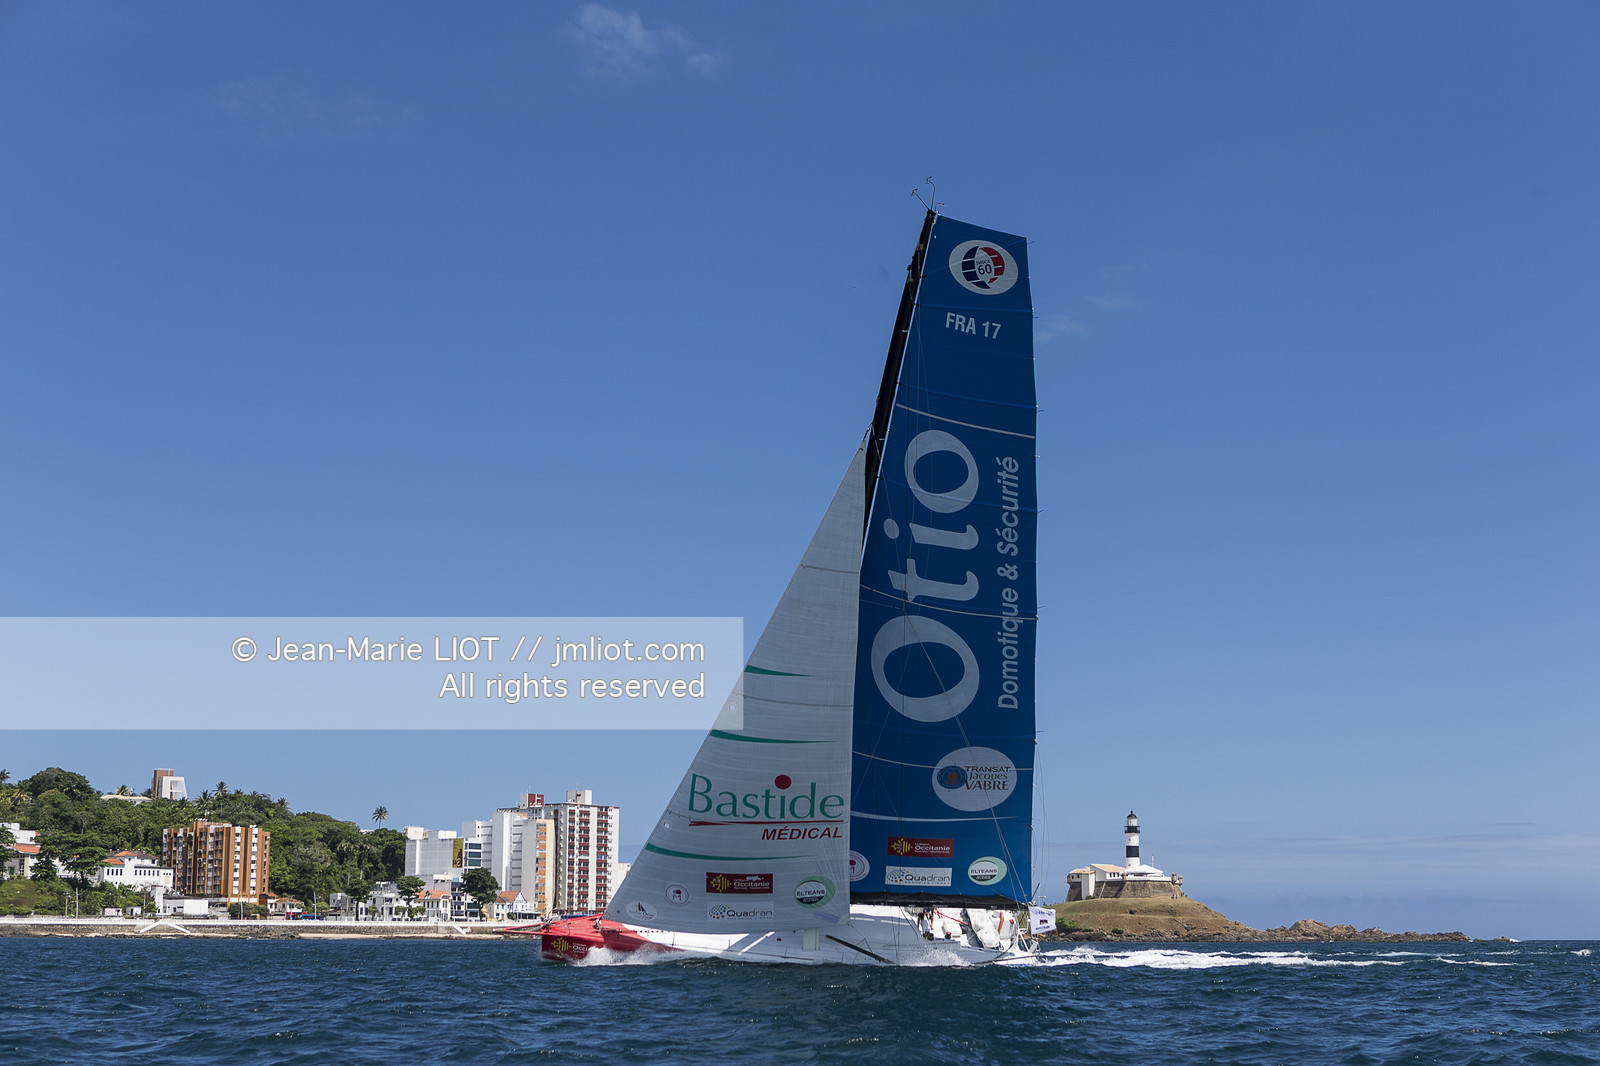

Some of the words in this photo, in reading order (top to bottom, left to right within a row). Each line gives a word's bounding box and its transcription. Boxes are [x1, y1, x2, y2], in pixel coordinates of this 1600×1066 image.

[978, 264, 992, 275] 60
[945, 311, 976, 335] FRA
[982, 320, 1001, 339] 17
[995, 456, 1019, 557] Sécurité
[871, 430, 980, 722] Otio
[996, 562, 1019, 581] &
[997, 587, 1023, 709] Domotique
[968, 771, 1008, 781] Jacques
[964, 779, 1009, 790] VABRE
[688, 773, 844, 819] Bastide
[761, 827, 843, 841] MÉDICAL
[733, 880, 770, 888] Occitanie
[904, 874, 951, 883] Quadran
[726, 909, 773, 918] Quadran
